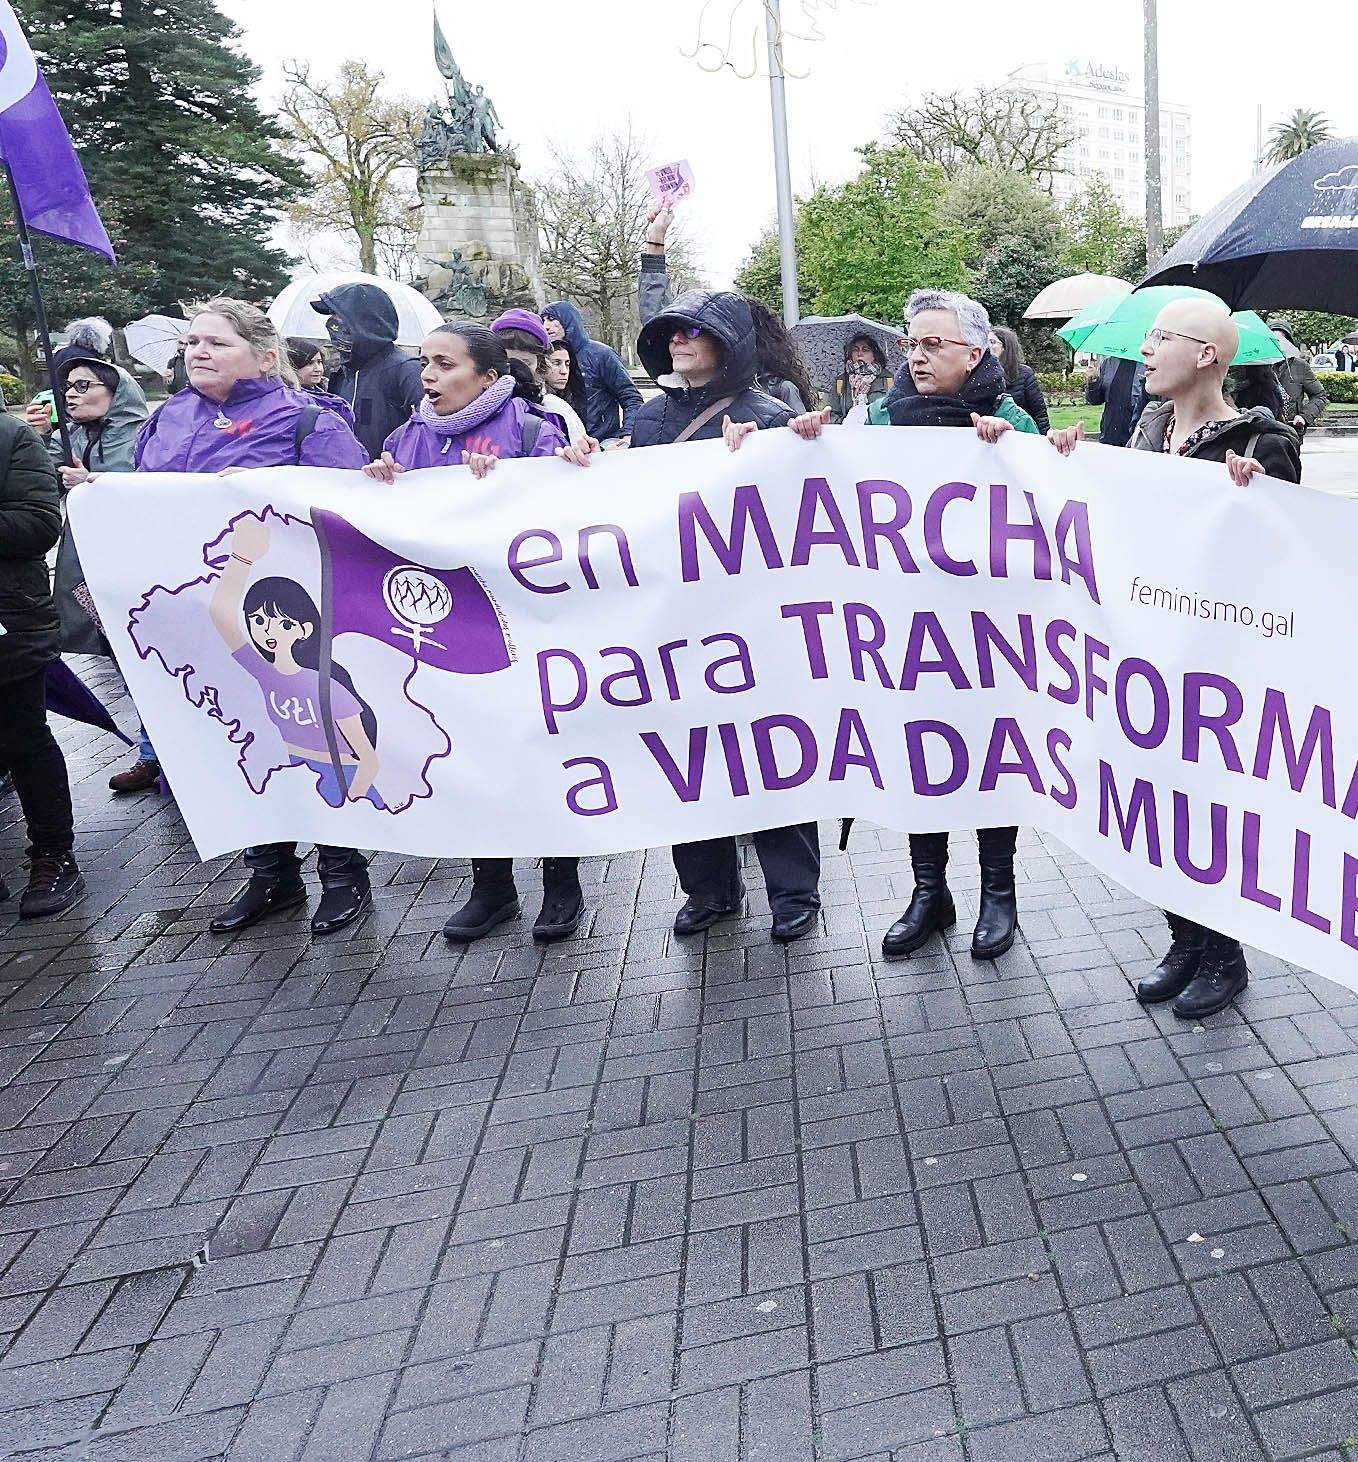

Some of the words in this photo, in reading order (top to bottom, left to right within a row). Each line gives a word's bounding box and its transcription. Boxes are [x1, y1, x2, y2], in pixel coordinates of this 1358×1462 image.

[1086, 60, 1130, 81] Adeslas
[507, 528, 639, 594] en
[678, 477, 1101, 605] MARCHA
[1130, 576, 1294, 638] feminismo.gal
[536, 632, 756, 735] para
[562, 756, 619, 817] a
[638, 708, 885, 803] VIDA
[904, 717, 1078, 810] DAS
